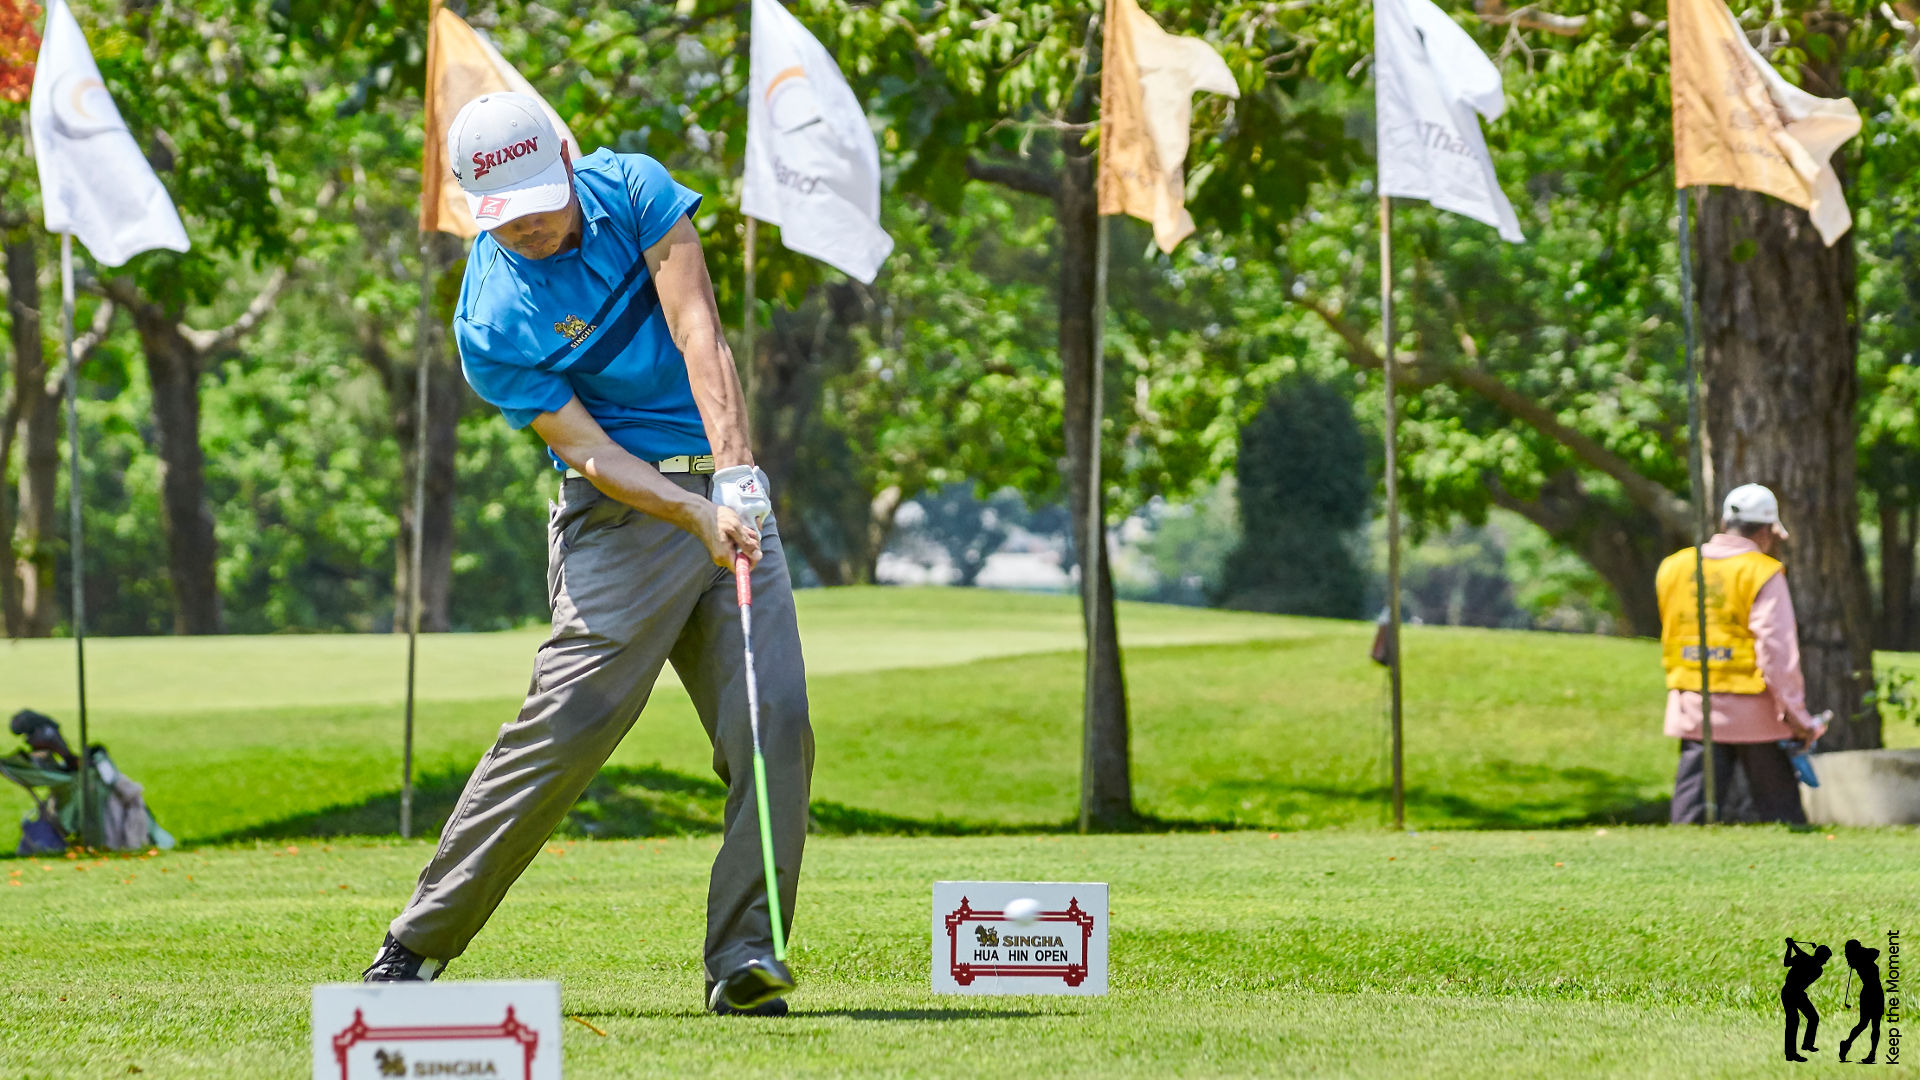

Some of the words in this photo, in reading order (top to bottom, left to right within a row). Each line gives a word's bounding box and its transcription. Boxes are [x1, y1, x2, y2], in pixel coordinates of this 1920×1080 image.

[472, 136, 538, 180] SRIXON
[570, 325, 597, 349] SINGHA
[1002, 935, 1064, 947] SINGHA
[973, 950, 999, 961] HUA
[1008, 950, 1028, 961] HIN
[1035, 950, 1068, 961] OPEN
